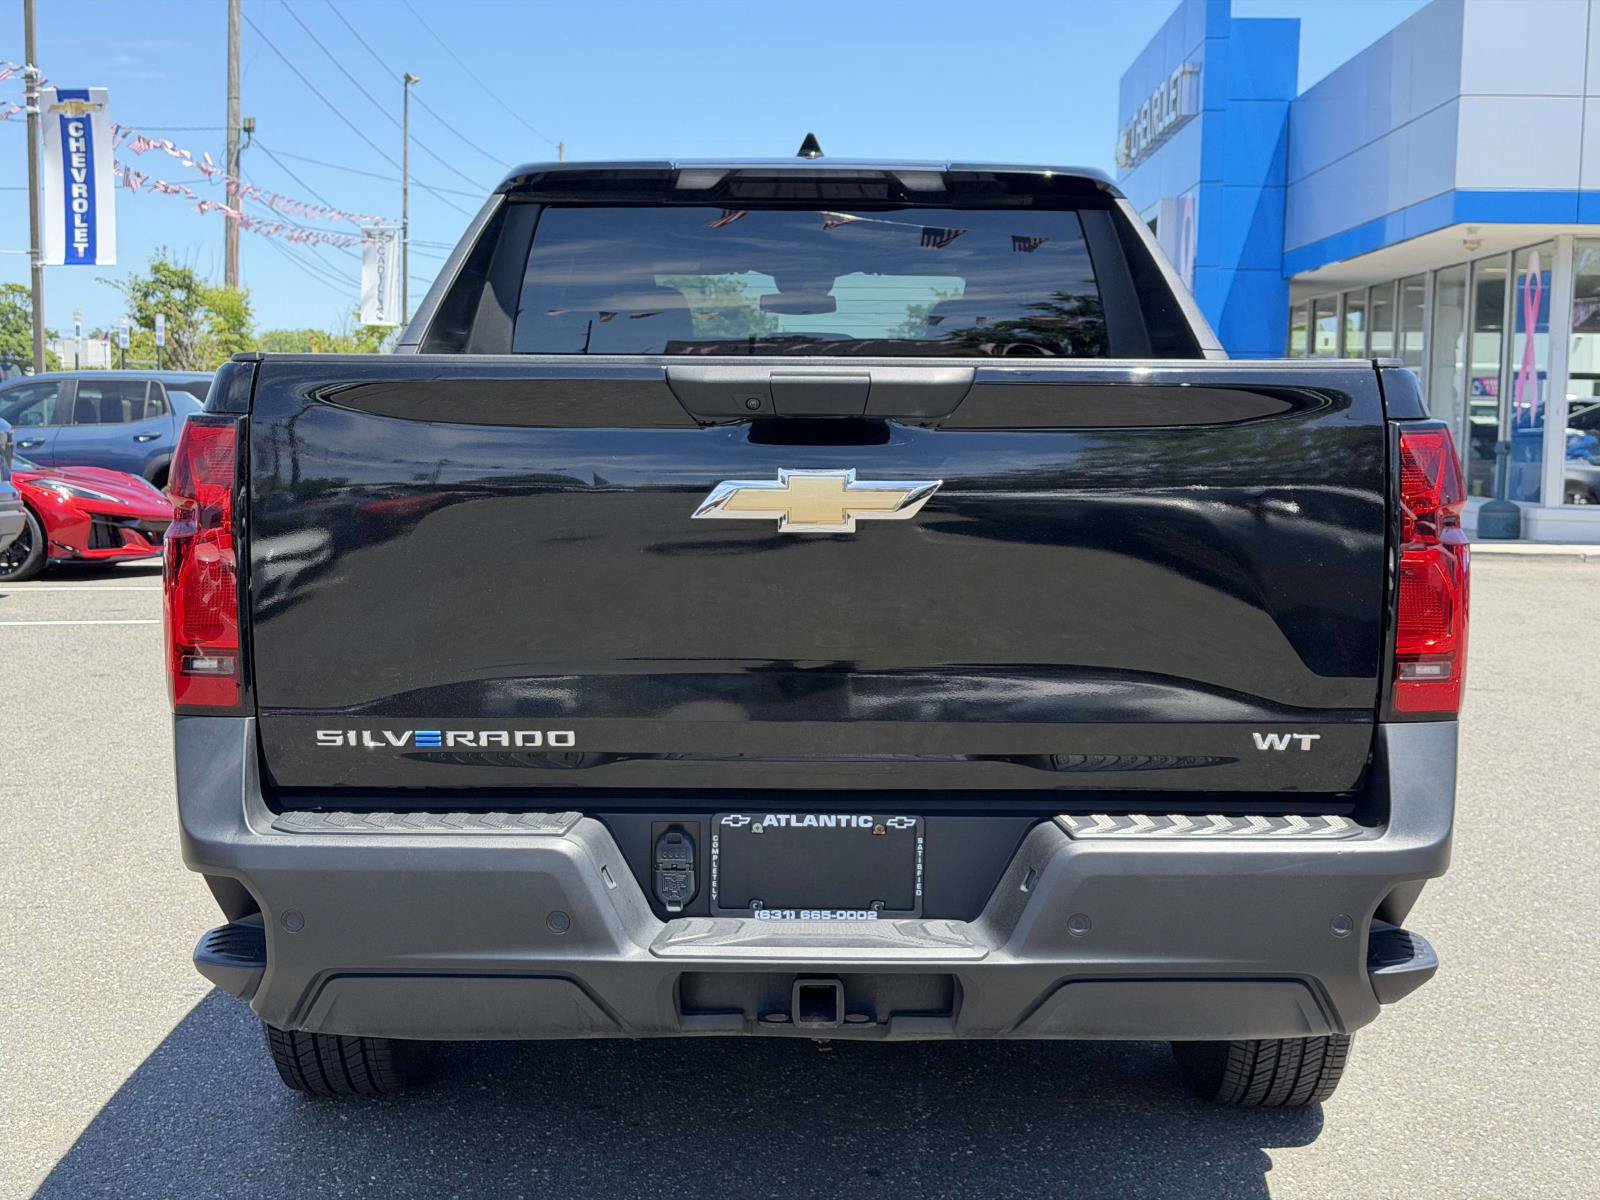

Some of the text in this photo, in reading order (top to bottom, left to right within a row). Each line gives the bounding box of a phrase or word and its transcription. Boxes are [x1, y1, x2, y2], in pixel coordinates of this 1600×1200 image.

[68, 121, 89, 258] CHEVROLET
[316, 730, 576, 747] SILVERADO
[1252, 732, 1321, 751] WT
[763, 814, 874, 828] ATLANTIC
[711, 834, 720, 900] COMPLETELY
[915, 837, 924, 896] SATISFIED
[754, 909, 878, 921] (631) 665-0002
